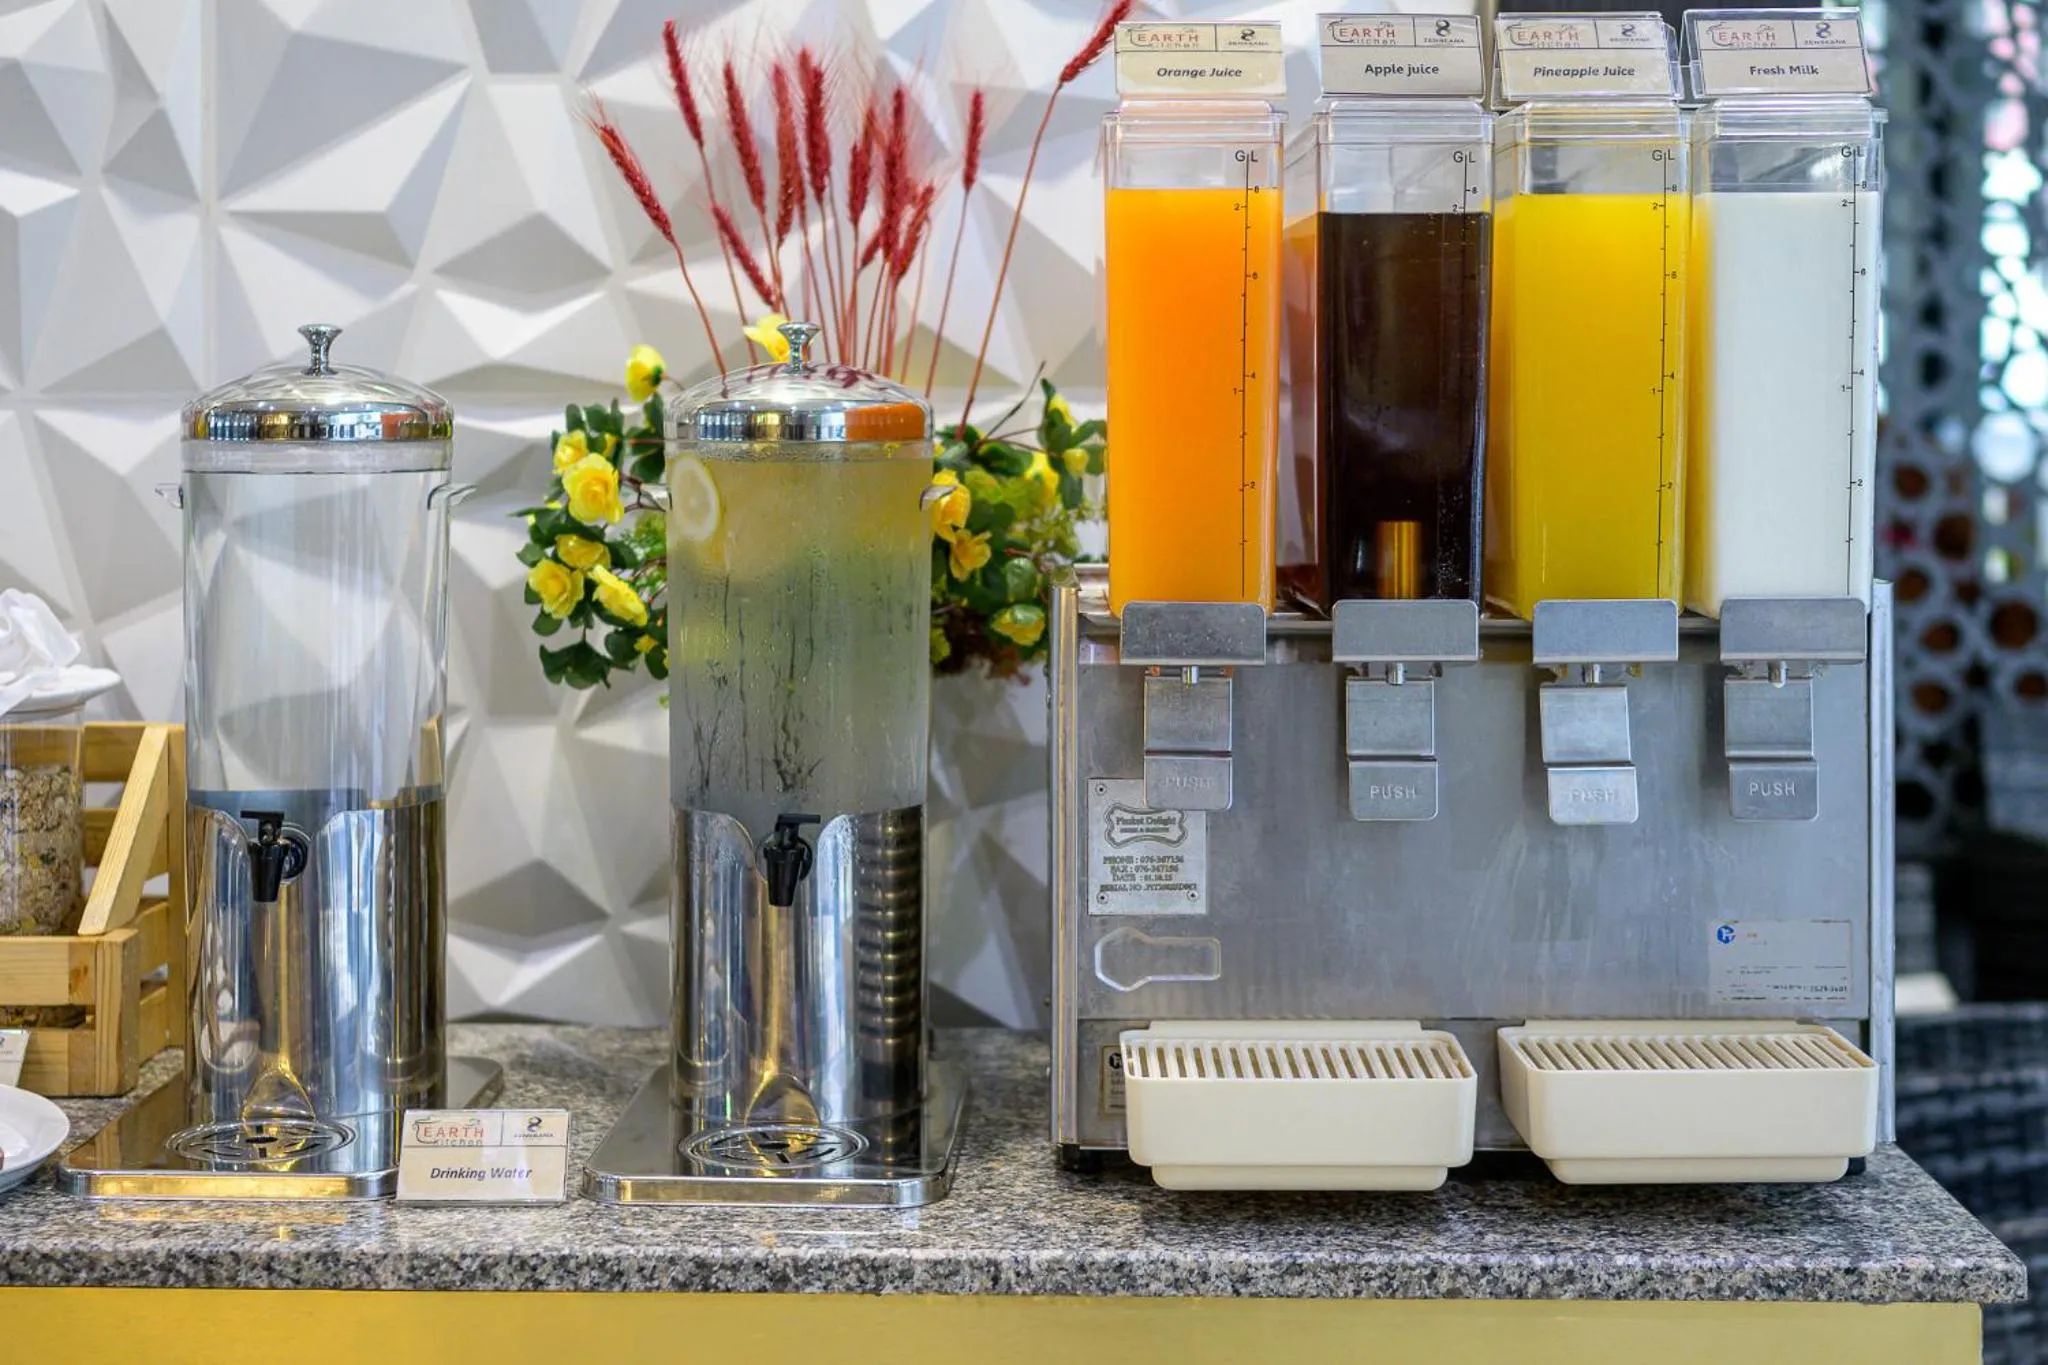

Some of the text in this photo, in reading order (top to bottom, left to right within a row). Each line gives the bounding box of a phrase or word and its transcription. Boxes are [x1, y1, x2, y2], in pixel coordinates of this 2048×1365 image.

[1137, 33, 1199, 43] EARTH
[1338, 27, 1396, 38] EARTH
[1517, 31, 1580, 41] EARTH
[1717, 31, 1776, 41] EARTH
[1157, 67, 1242, 78] Orange Juice
[1365, 64, 1439, 77] Apple juice
[1533, 66, 1635, 78] Pineapple Juice
[1750, 65, 1819, 75] Fresh Milk
[1235, 149, 1259, 162] G L
[1453, 150, 1476, 163] G L
[1652, 148, 1675, 161] G L
[1841, 145, 1864, 158] G L
[1234, 203, 1240, 211] 2
[1452, 204, 1458, 212] 2
[1652, 202, 1659, 210] 2
[1842, 199, 1848, 207] 2
[1860, 268, 1866, 276] 6
[1857, 479, 1863, 487] 2
[1370, 785, 1416, 799] PUSH
[1571, 788, 1617, 801] PUSH
[1749, 782, 1796, 797] PUSH
[424, 1127, 484, 1138] EARTH
[430, 1167, 533, 1181] Drinking Water
